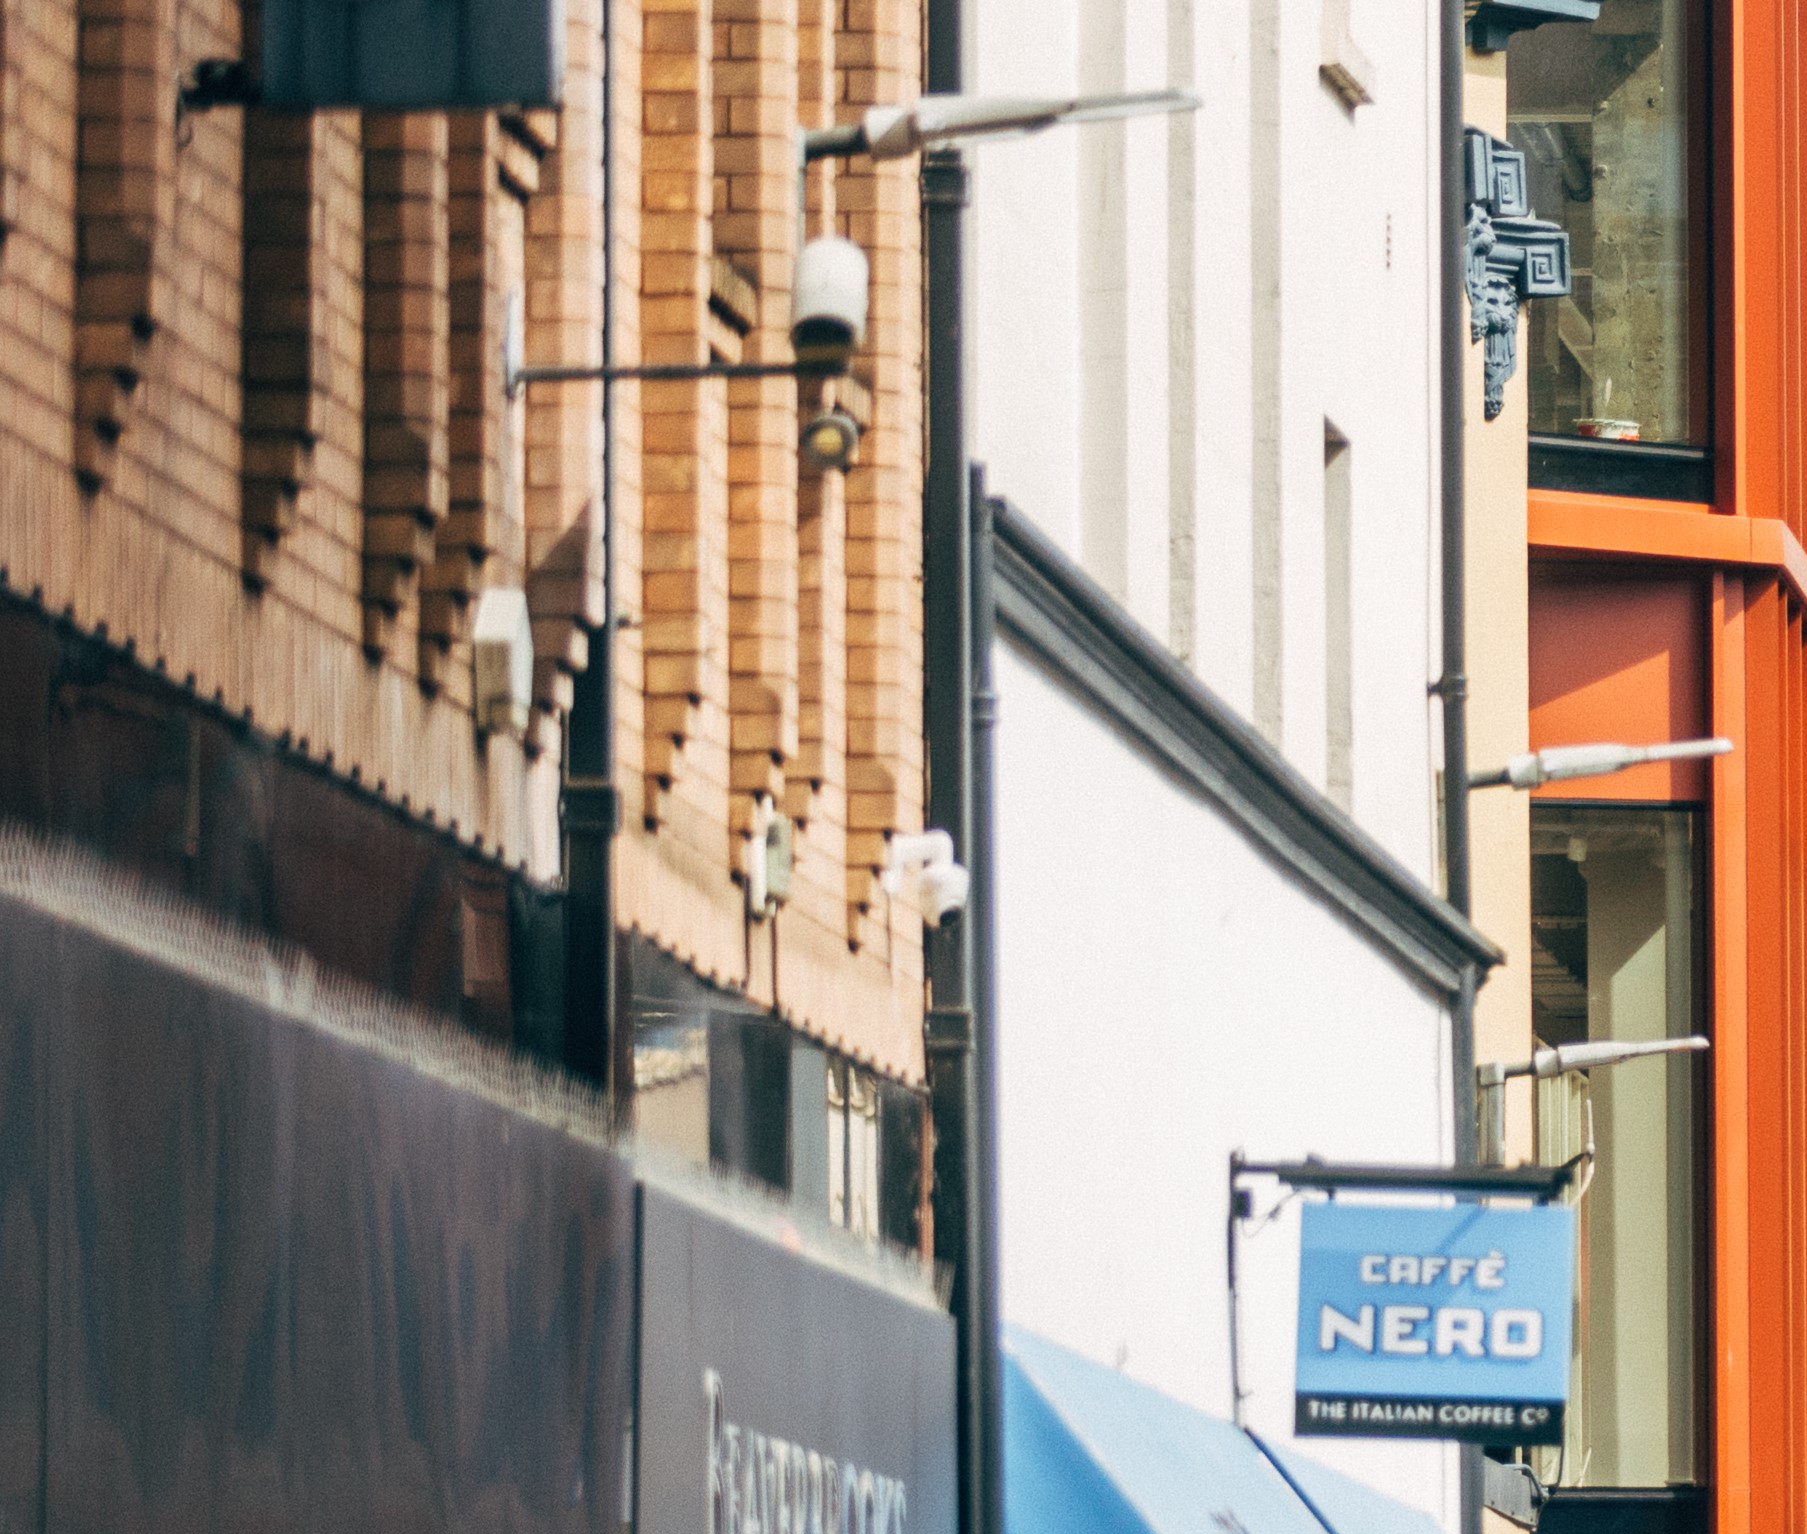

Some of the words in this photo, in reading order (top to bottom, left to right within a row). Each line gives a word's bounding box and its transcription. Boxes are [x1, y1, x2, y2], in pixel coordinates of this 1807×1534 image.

[1360, 1250, 1506, 1289] CAFFÈ
[1319, 1303, 1544, 1359] NERO
[1308, 1400, 1346, 1420] THE
[1352, 1402, 1434, 1423] ITALIAN
[1440, 1404, 1515, 1425] COFFEE
